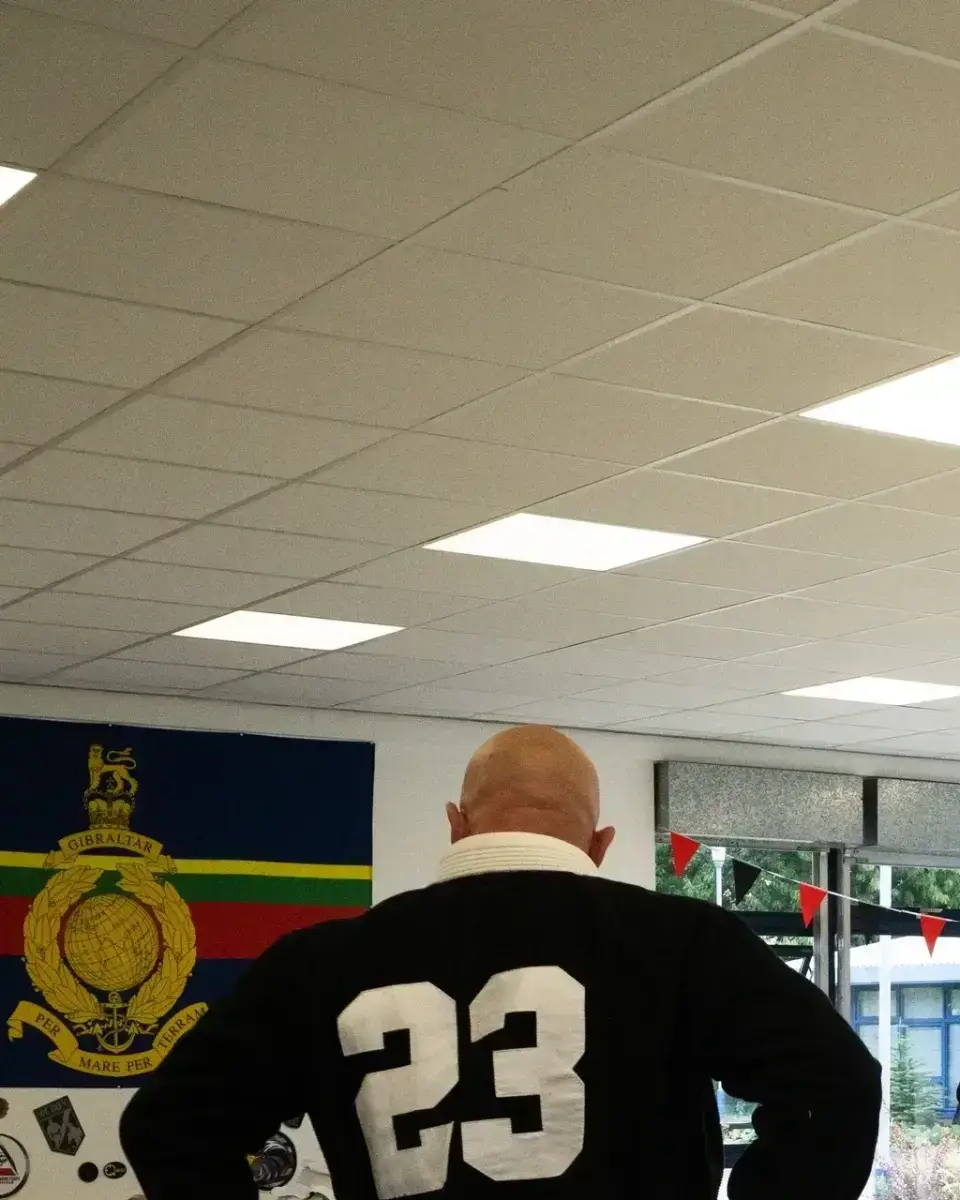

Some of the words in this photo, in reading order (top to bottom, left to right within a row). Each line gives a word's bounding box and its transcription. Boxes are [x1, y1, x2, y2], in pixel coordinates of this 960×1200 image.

[67, 833, 154, 852] GIBRALTAR
[35, 1010, 61, 1037] PER
[79, 1056, 121, 1073] MARE
[127, 1056, 153, 1073] PER
[336, 964, 587, 1200] 23
